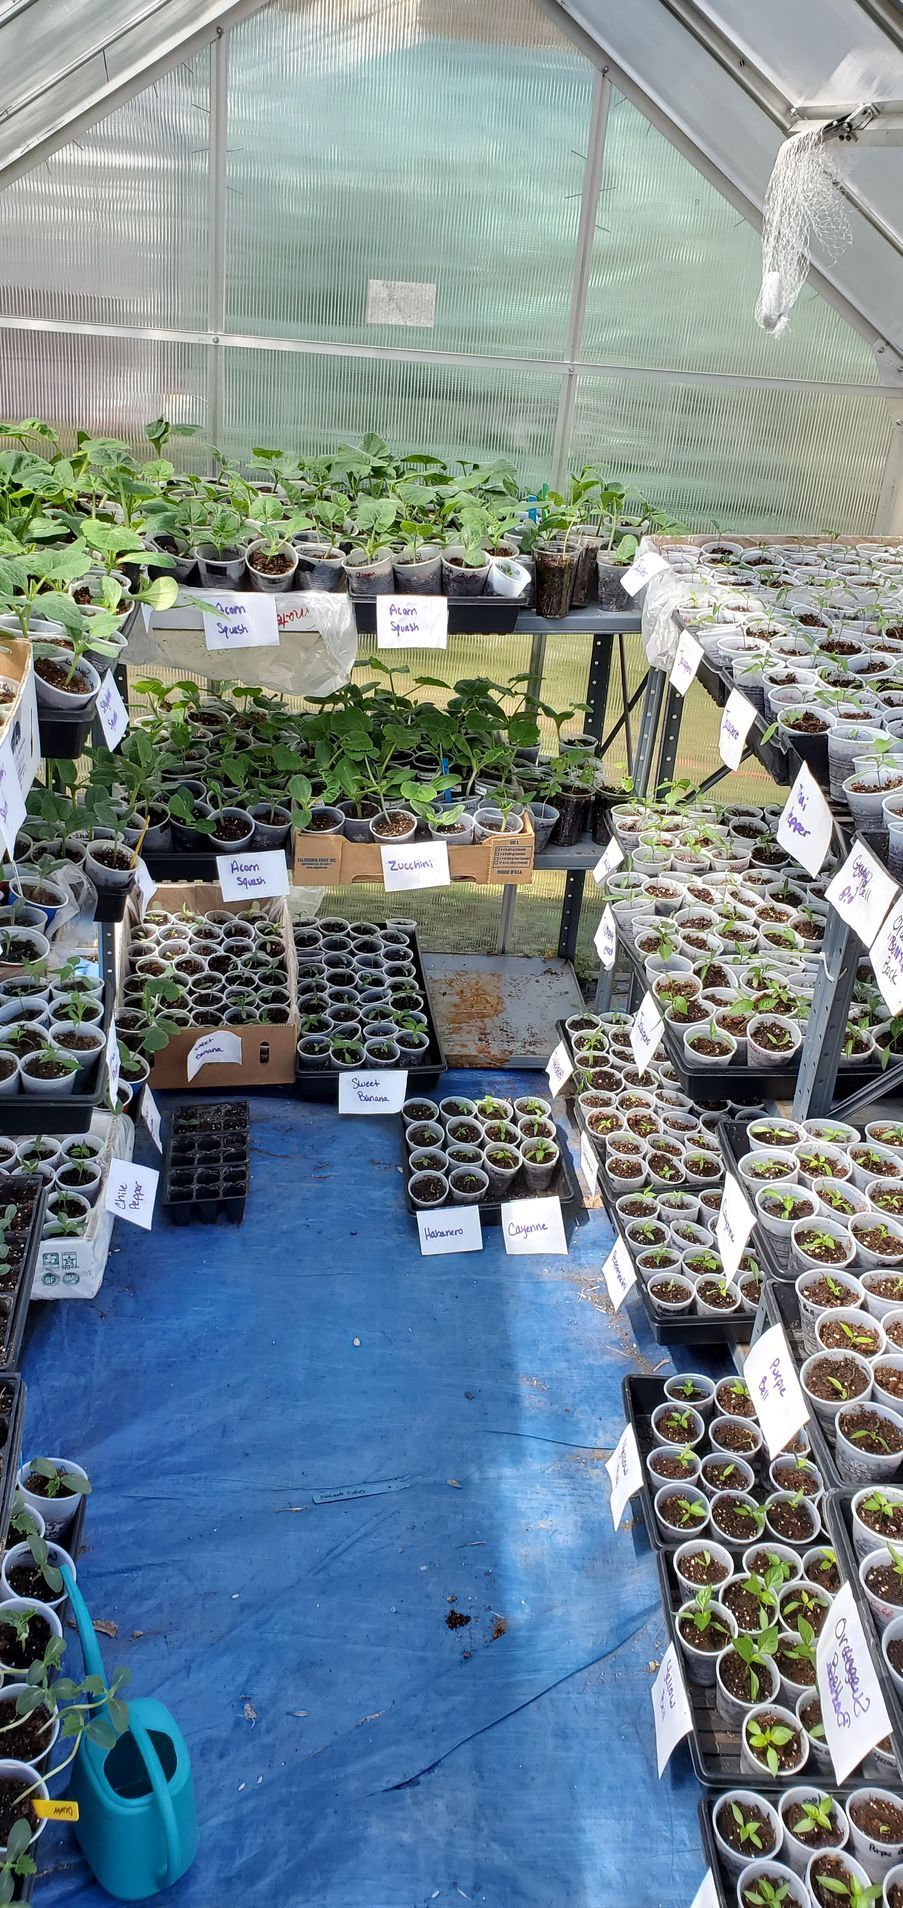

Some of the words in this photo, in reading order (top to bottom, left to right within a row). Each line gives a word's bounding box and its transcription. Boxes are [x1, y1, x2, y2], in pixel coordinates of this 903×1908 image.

[389, 603, 418, 616] Acorn
[217, 621, 249, 639] Squash
[390, 620, 420, 637] Squash
[231, 860, 260, 874] Acorn
[387, 859, 434, 872] Zucchini
[236, 876, 267, 889] Squash
[352, 1077, 381, 1089] Sweet
[356, 1091, 390, 1102] Banana
[114, 1182, 128, 1209] Chile
[129, 1180, 144, 1210] Pepper
[424, 1226, 464, 1241] Habanero
[507, 1222, 549, 1239] Cayenne
[769, 1357, 786, 1398] Purple
[758, 1375, 769, 1401] Bell
[663, 1659, 676, 1709] Yellow
